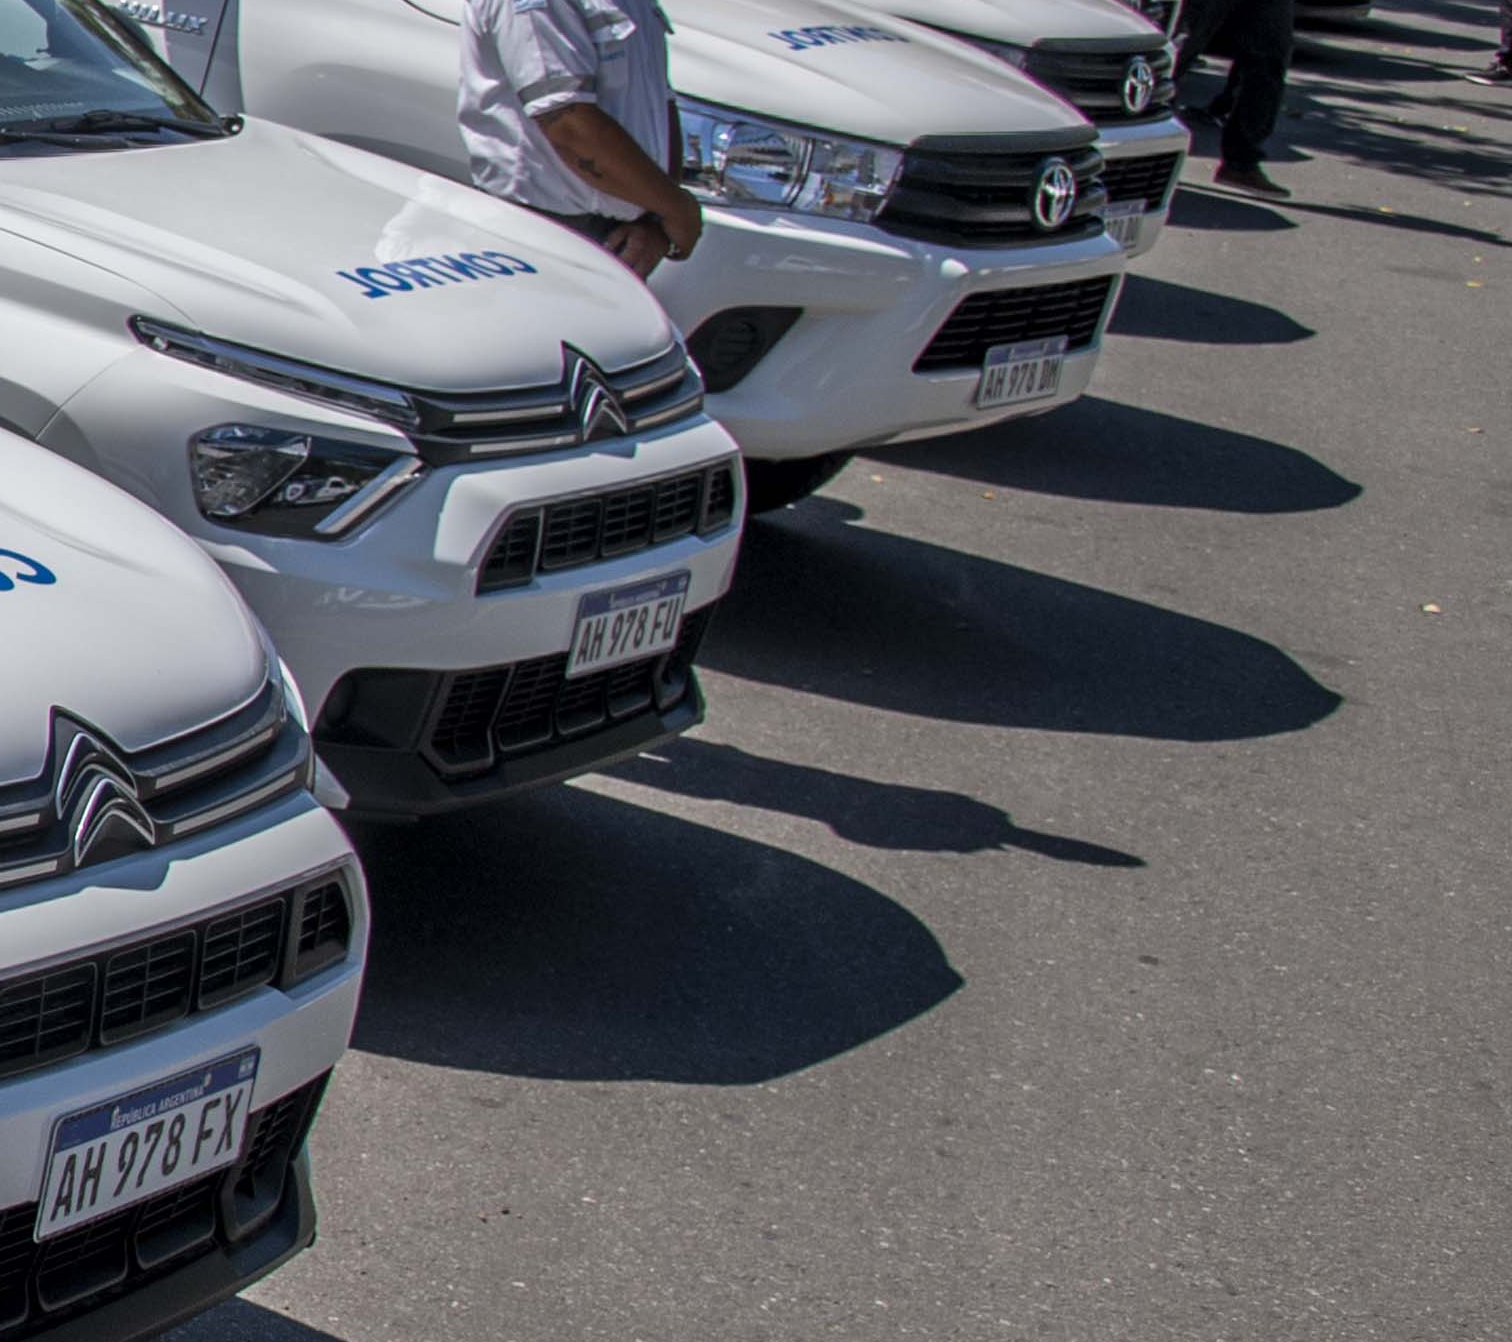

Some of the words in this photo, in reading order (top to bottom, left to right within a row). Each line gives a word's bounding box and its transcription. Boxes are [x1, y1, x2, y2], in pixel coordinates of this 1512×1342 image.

[576, 616, 607, 664] AH
[608, 605, 649, 656] 978
[650, 596, 681, 645] FU
[50, 1141, 107, 1222] AH
[113, 1112, 186, 1197] 978
[191, 1087, 244, 1165] FX
